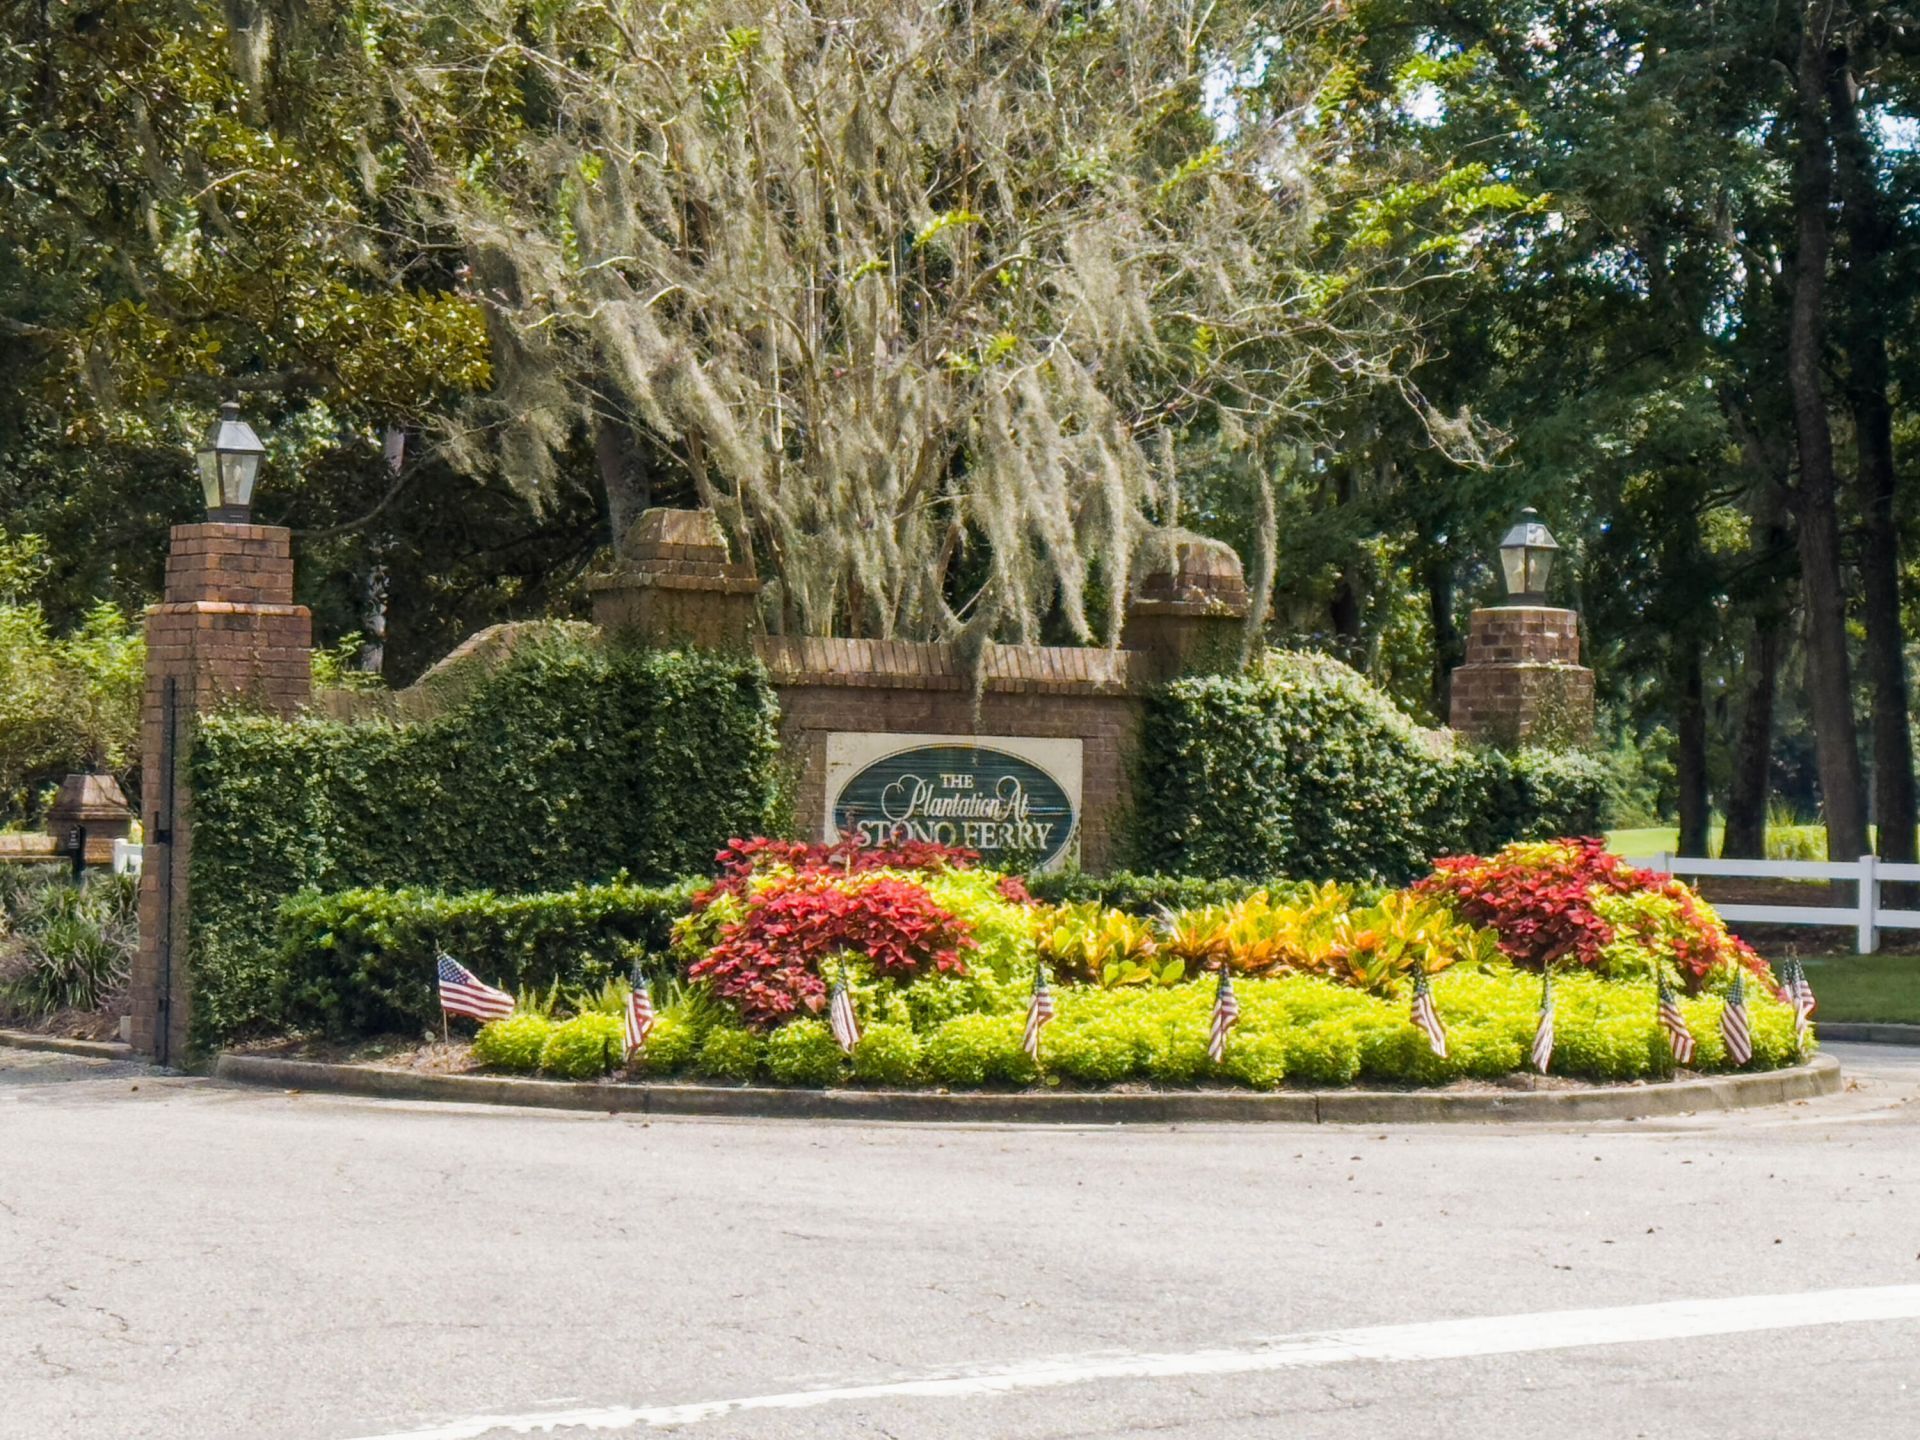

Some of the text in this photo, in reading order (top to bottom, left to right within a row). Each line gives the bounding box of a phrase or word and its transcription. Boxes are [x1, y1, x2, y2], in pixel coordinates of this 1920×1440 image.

[941, 774, 973, 788] THE
[881, 774, 1029, 822] Plantation At
[857, 820, 1053, 849] STONO FERRY
